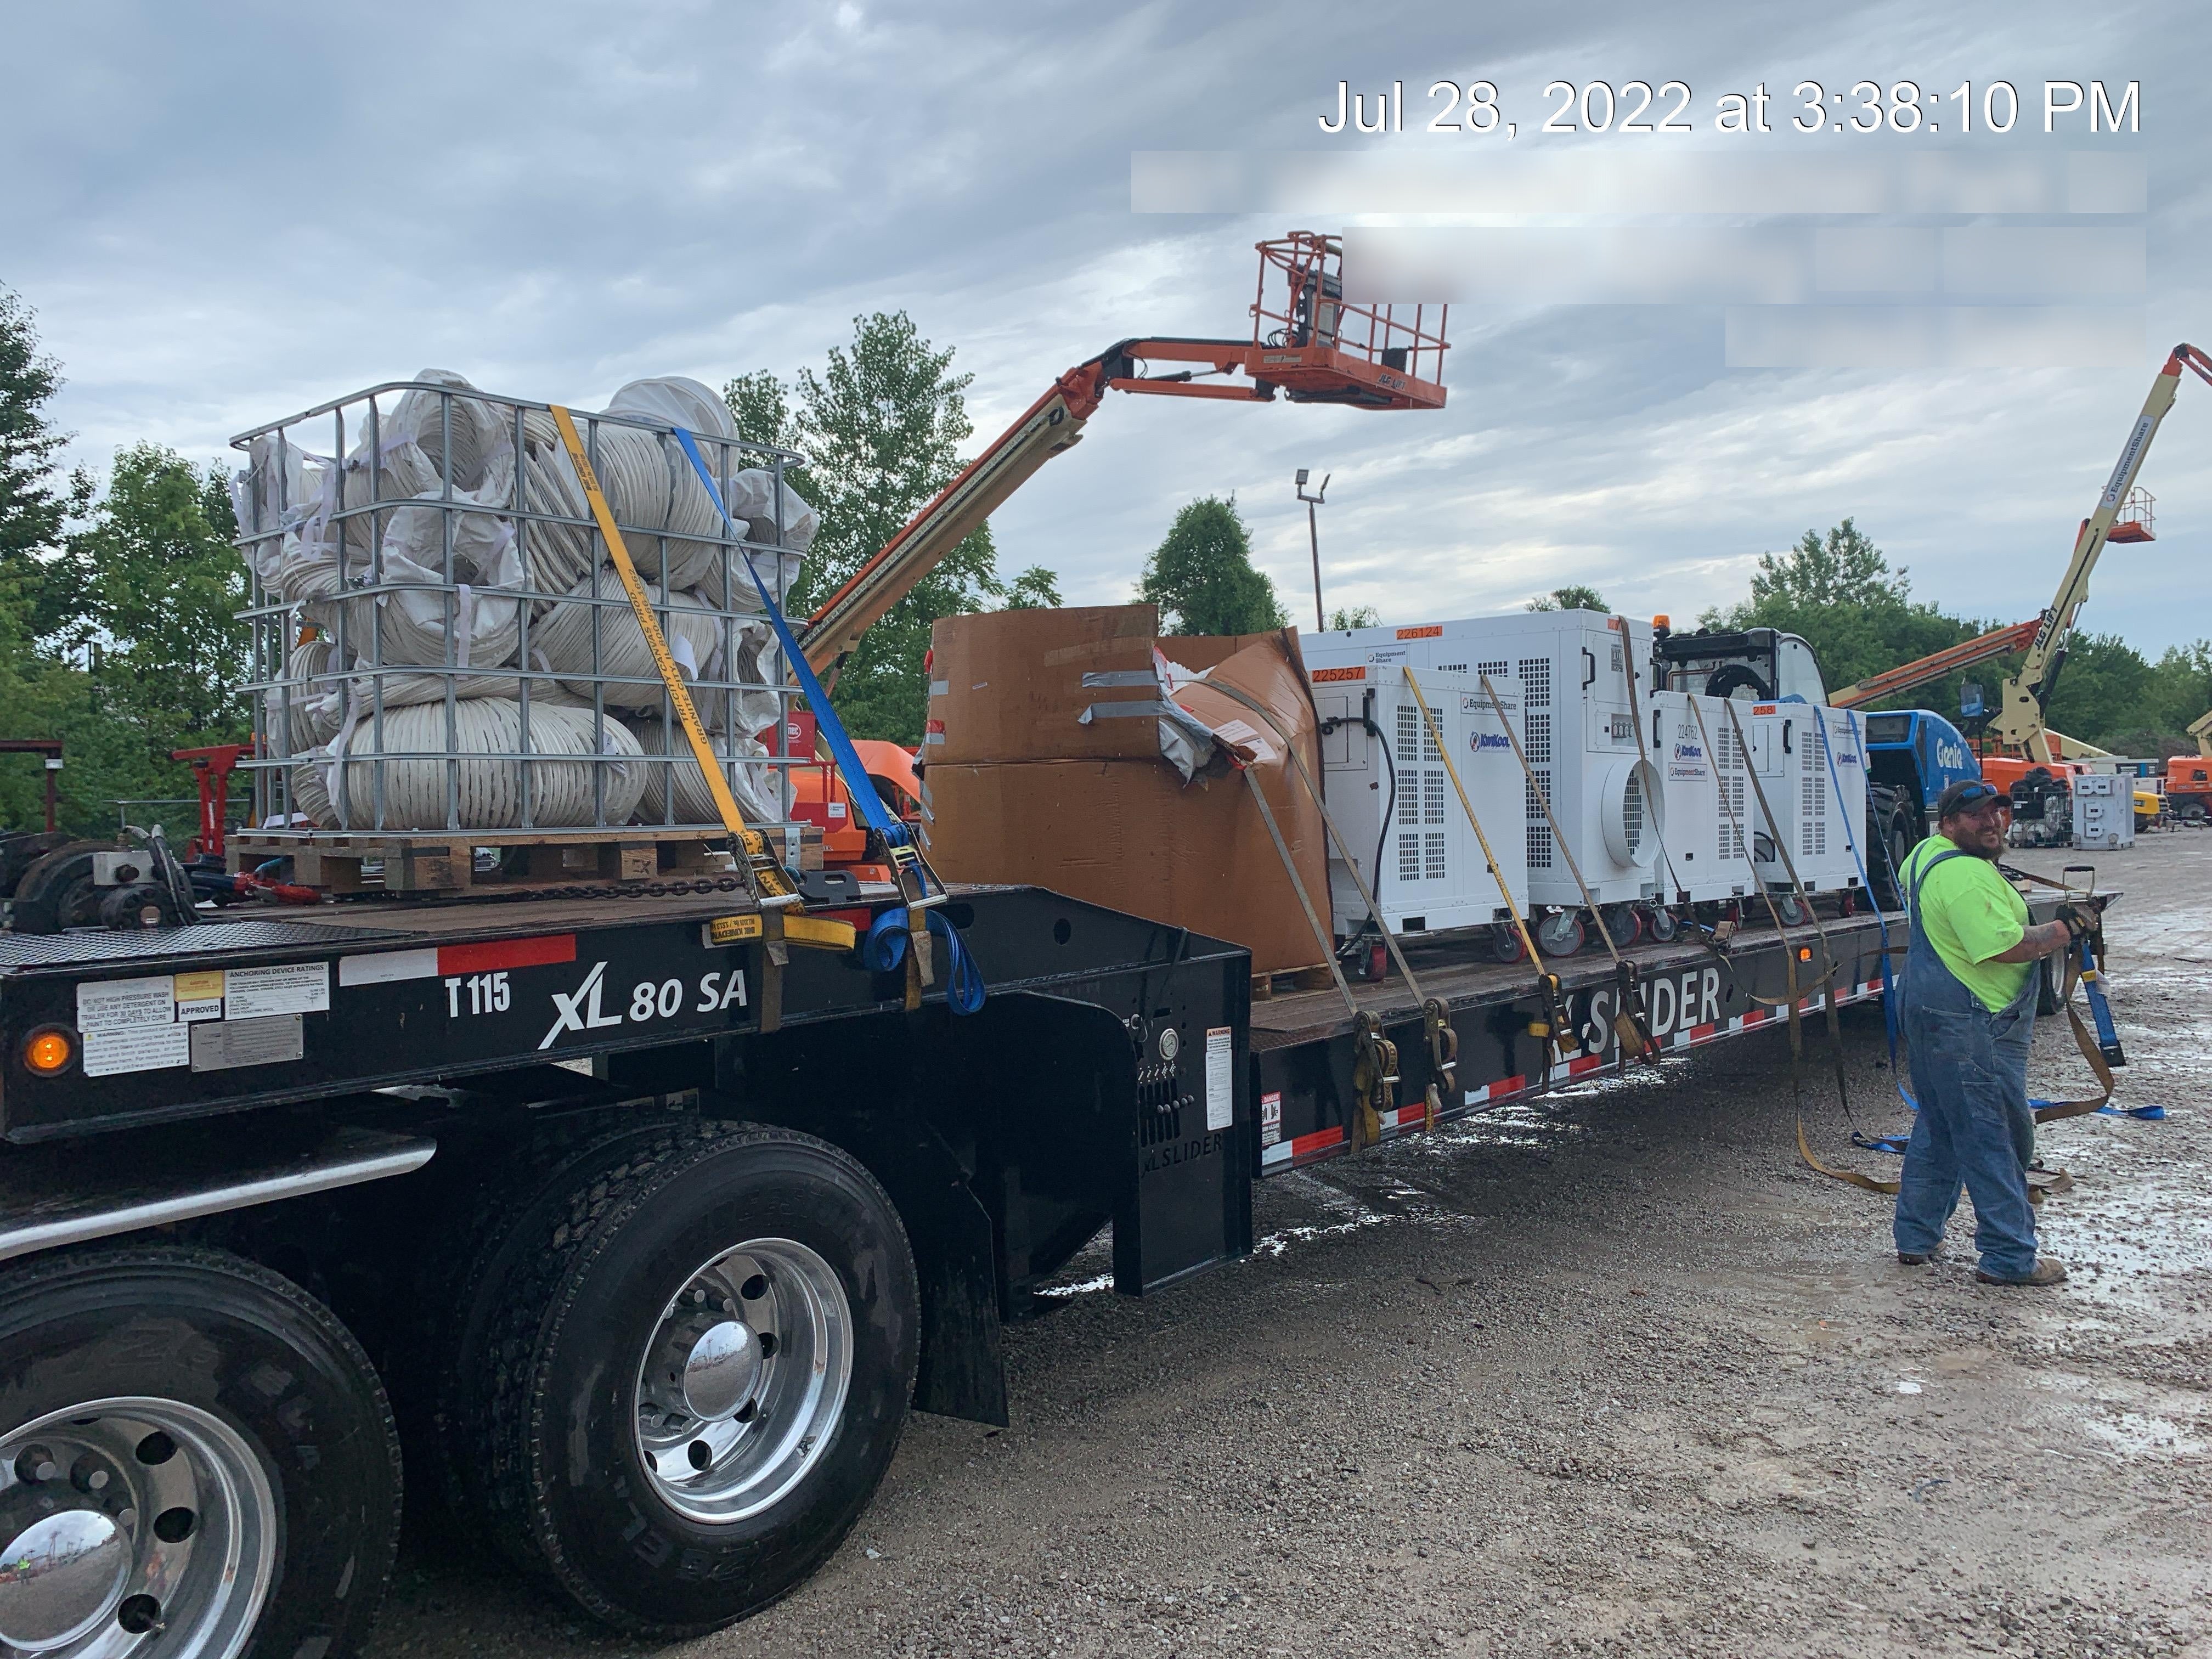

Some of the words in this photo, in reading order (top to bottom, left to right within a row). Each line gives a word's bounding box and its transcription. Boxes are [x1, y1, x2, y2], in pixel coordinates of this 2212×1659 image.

[2111, 422, 2149, 493] EquipmentShare
[1397, 627, 1440, 639] 226124
[2034, 629, 2047, 651] JLG
[2044, 605, 2058, 630] LIFT
[644, 627, 668, 672] CANVAS
[1313, 667, 1362, 682] 225257
[664, 675, 689, 723] TRI-CITY
[681, 694, 708, 745] GRANITE
[1678, 724, 1698, 740] 224762
[1937, 737, 1963, 769] Genie
[229, 969, 270, 978] ANCHORING
[122, 992, 152, 1001] PRESSURE
[180, 1005, 219, 1015] APPROVED
[537, 961, 623, 1050] XL
[629, 978, 683, 1022] 80
[696, 969, 748, 1012] SA
[113, 1015, 150, 1025] COMPLETELY
[1162, 1133, 1222, 1167] SLIDER
